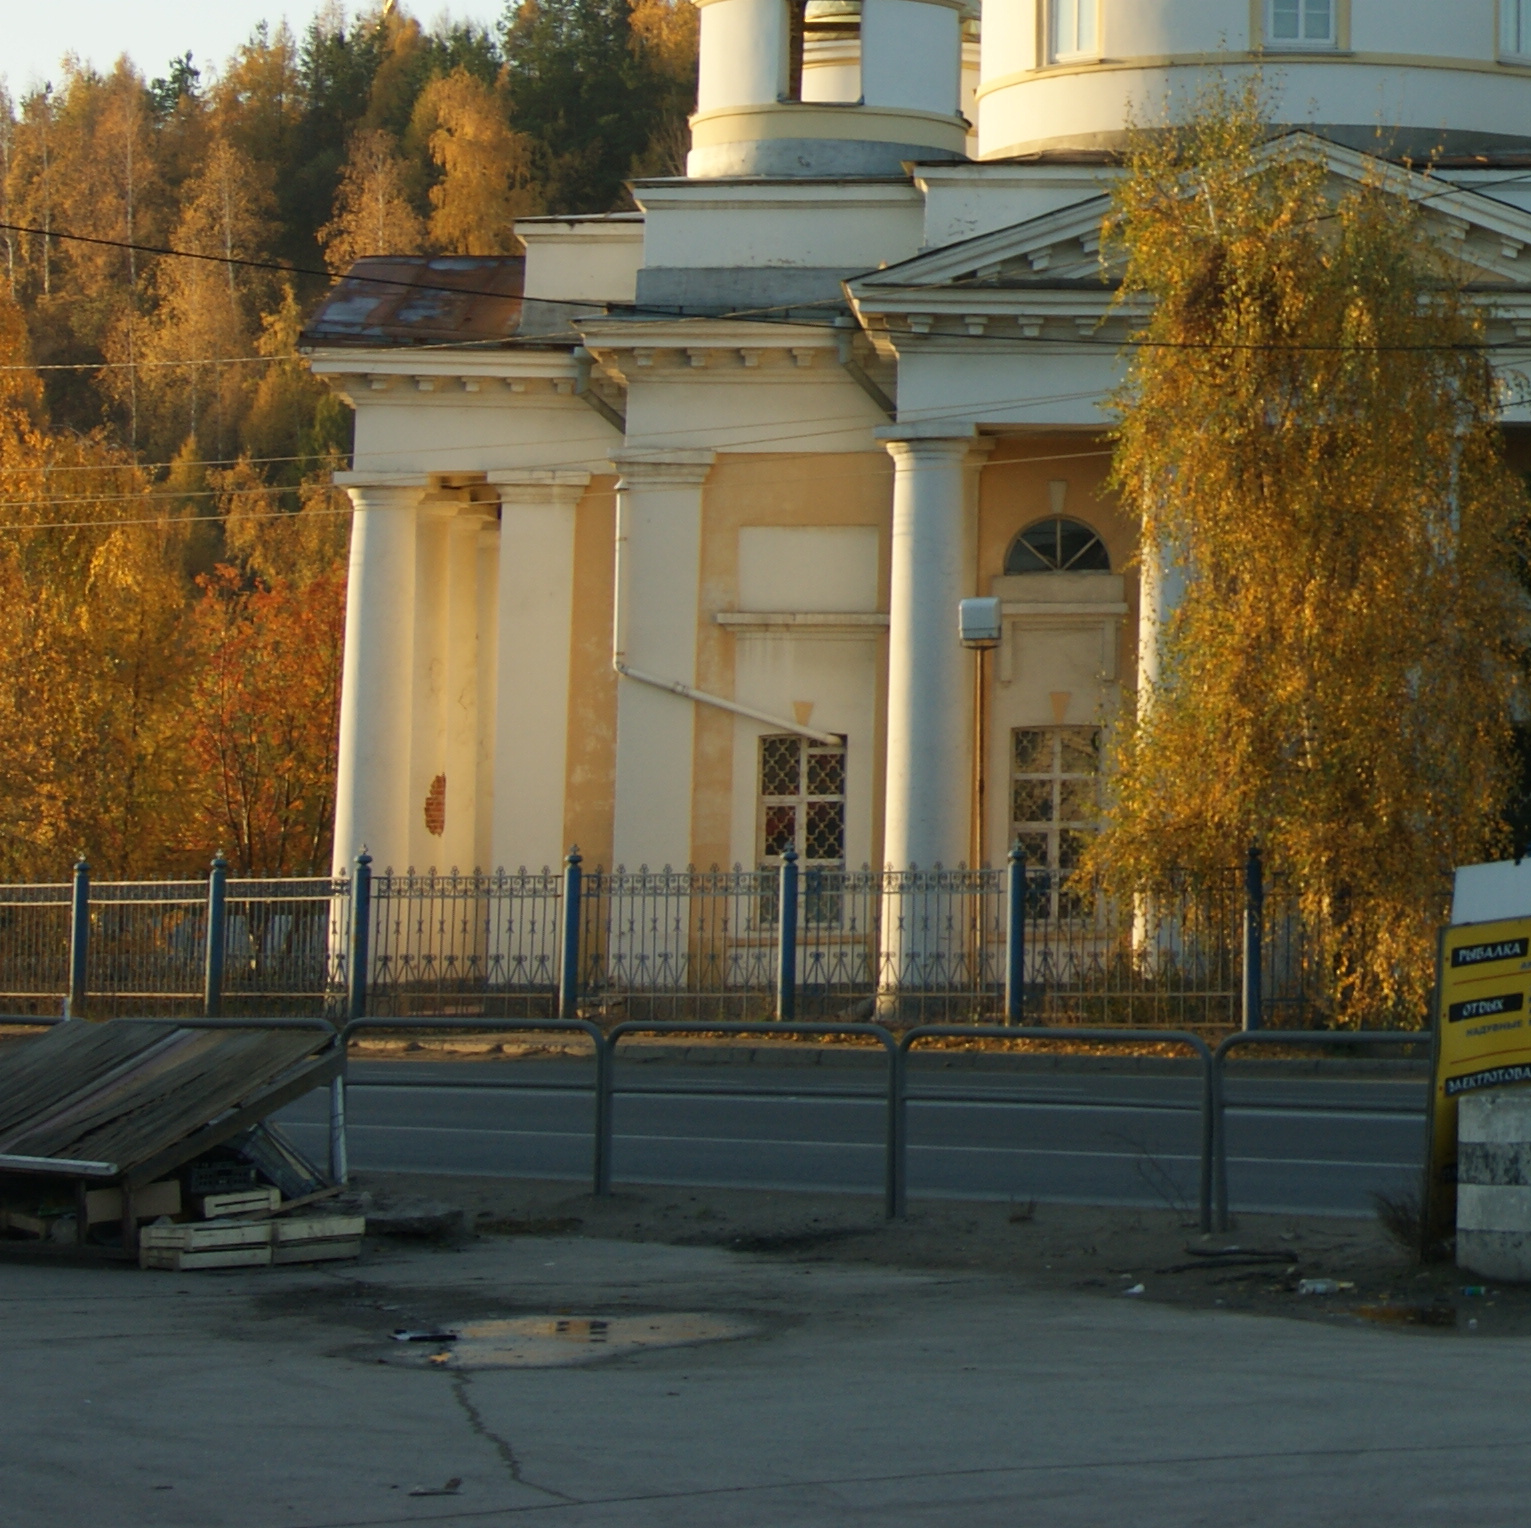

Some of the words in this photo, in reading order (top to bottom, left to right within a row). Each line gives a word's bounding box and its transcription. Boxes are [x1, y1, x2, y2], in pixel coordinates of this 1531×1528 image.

[1458, 942, 1522, 962] РЫБАЛКА
[1462, 999, 1504, 1017] ОТДЫХ
[1465, 1019, 1523, 1037] НАДУВНЫЕ
